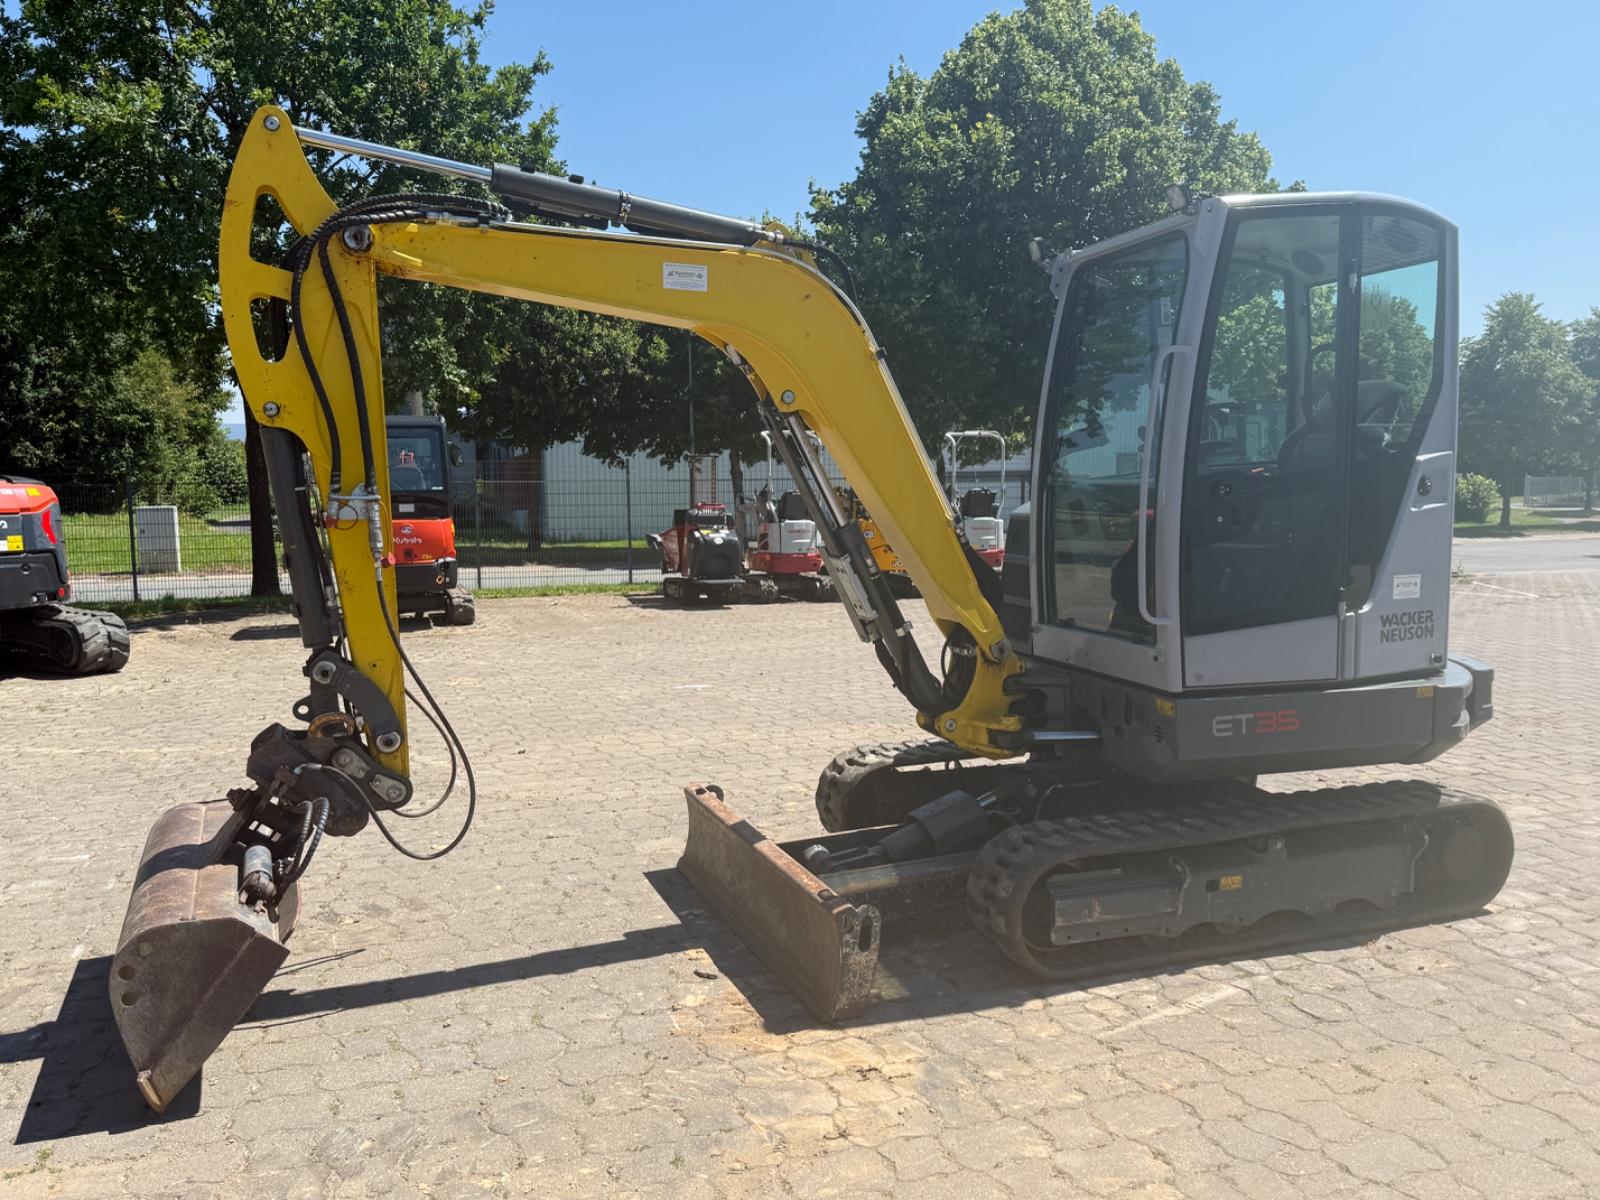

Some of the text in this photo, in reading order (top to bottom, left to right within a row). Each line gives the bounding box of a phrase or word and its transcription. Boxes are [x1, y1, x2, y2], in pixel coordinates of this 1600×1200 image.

[1380, 610, 1434, 628] WACKER
[1380, 624, 1434, 643] NEUSON
[1212, 709, 1301, 737] ET35
